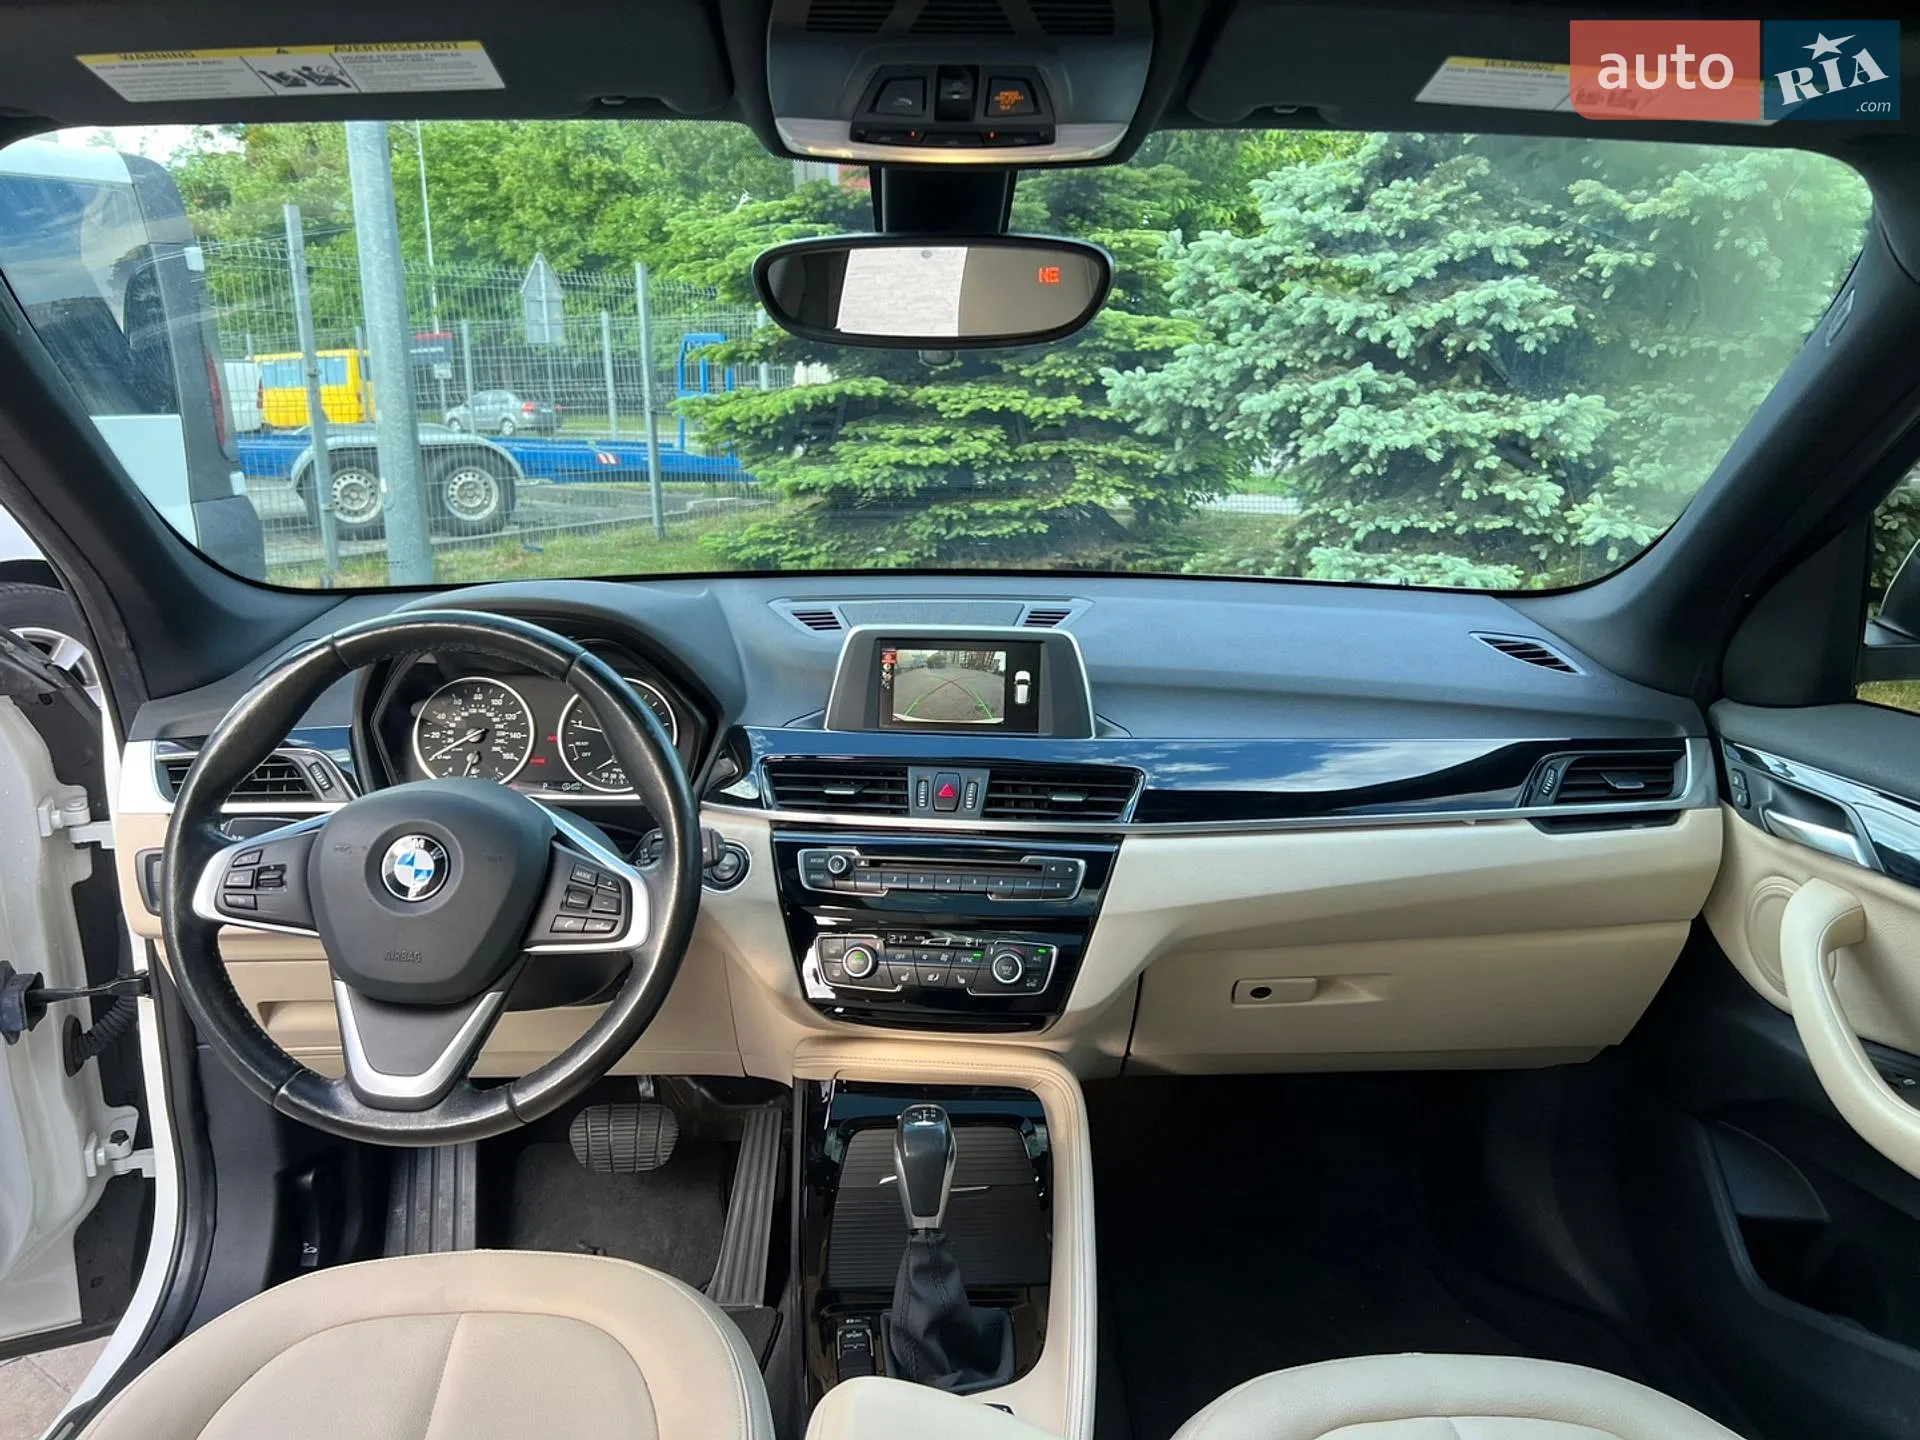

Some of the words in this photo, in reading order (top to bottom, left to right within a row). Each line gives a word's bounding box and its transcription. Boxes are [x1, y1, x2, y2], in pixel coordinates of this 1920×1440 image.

[334, 42, 460, 53] AVERTISSEMENT
[119, 51, 197, 61] WARNING
[1484, 59, 1555, 72] WARNING
[1039, 267, 1060, 283] NE
[385, 949, 423, 964] AIRBAG
